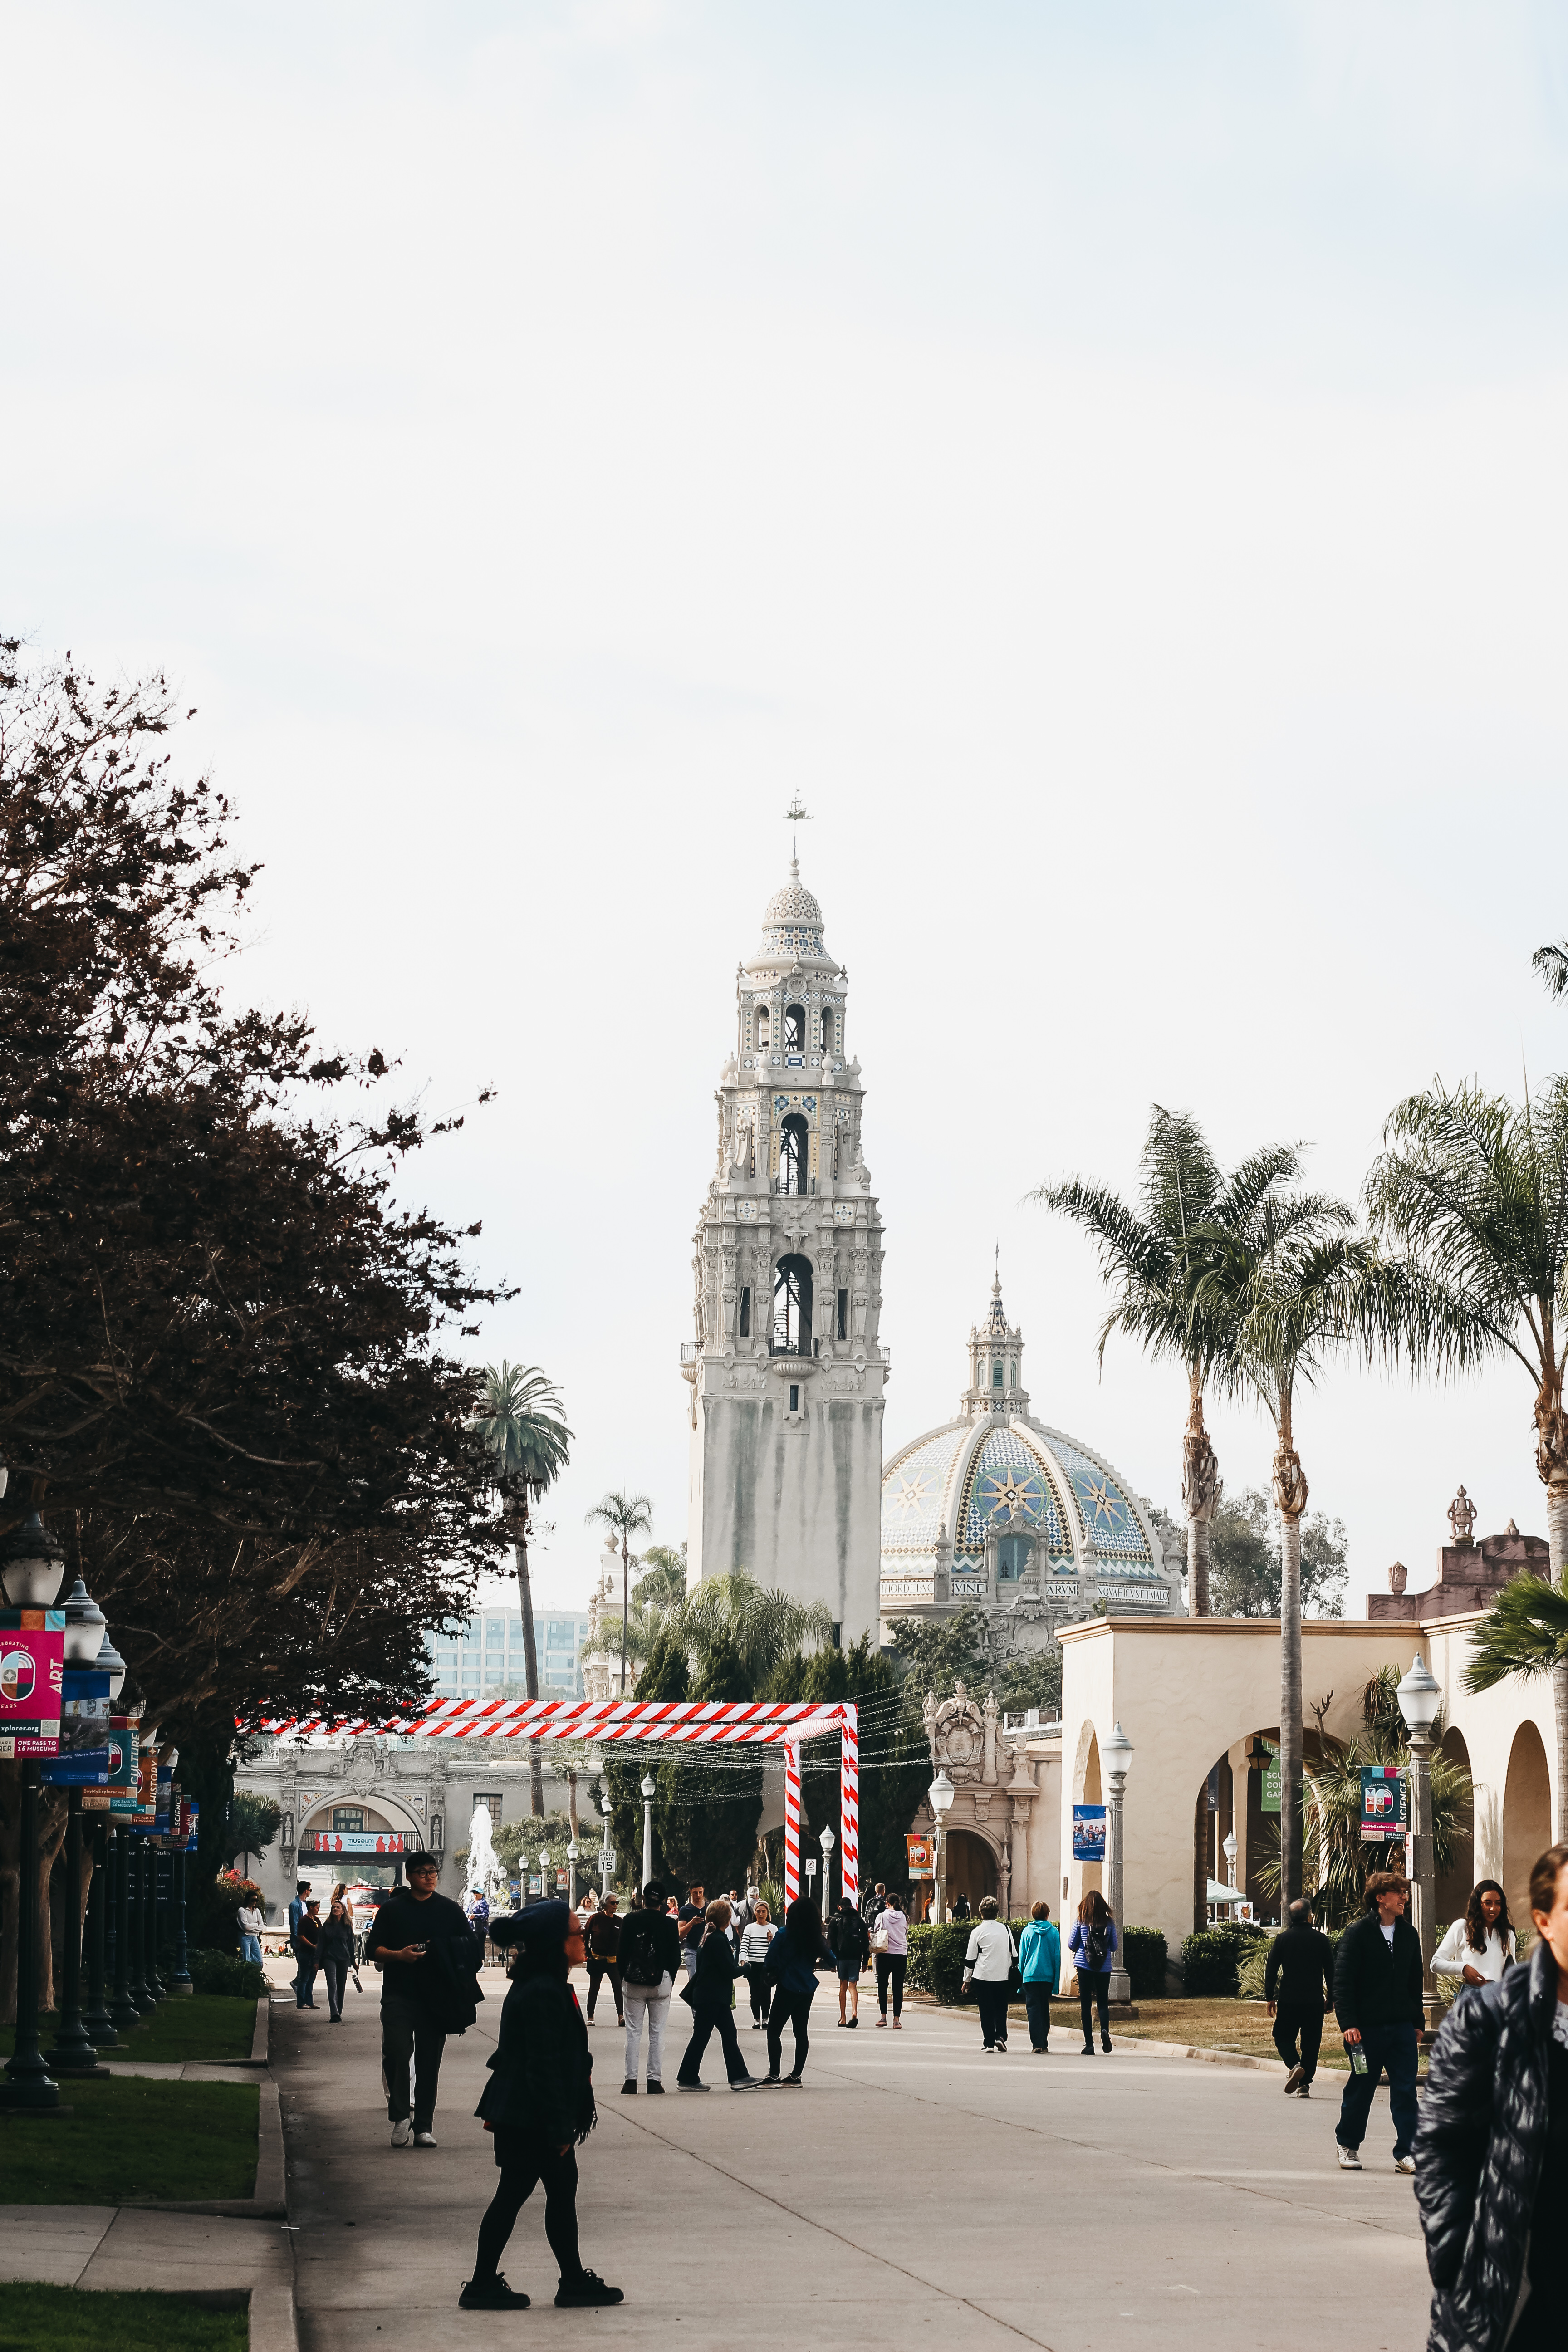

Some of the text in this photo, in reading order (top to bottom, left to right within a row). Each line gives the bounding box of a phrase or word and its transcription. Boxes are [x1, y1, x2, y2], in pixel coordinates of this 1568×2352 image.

[49, 1658, 63, 1694] ART
[131, 1733, 139, 1785] CULTURE
[602, 1862, 612, 1870] 15
